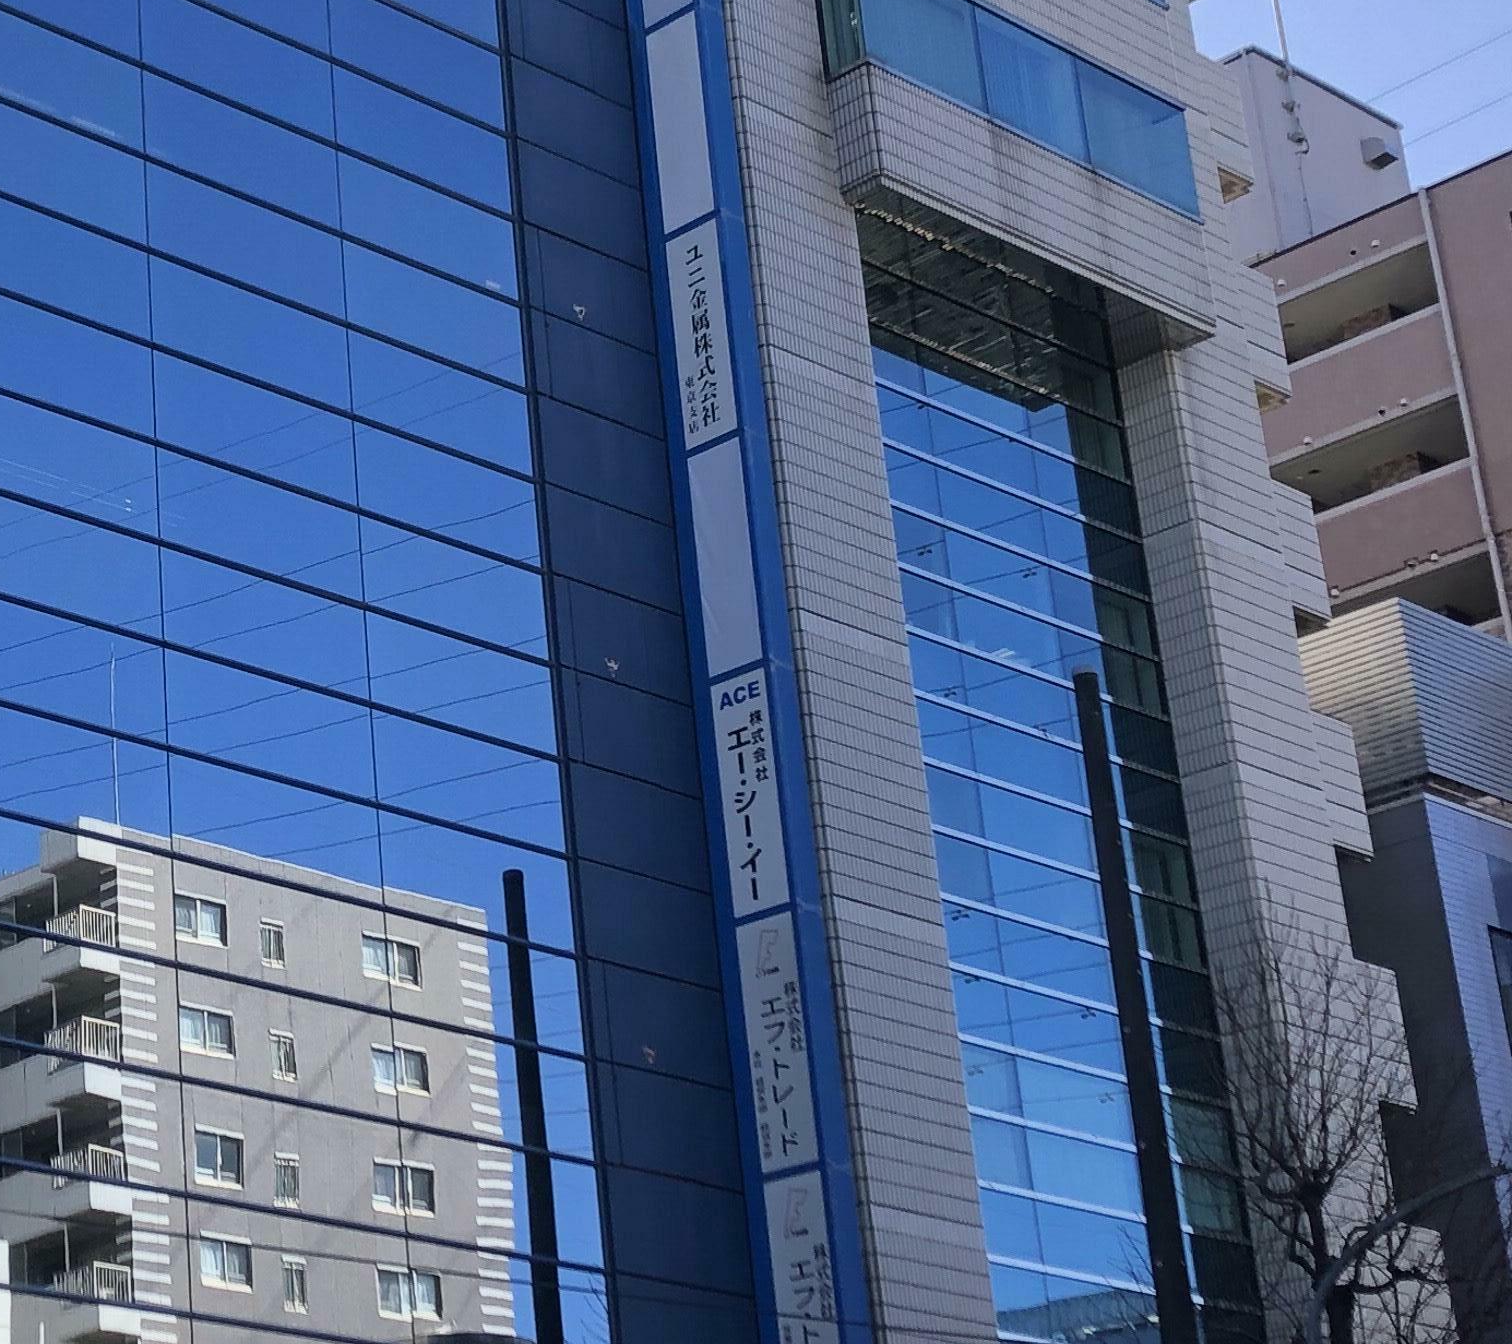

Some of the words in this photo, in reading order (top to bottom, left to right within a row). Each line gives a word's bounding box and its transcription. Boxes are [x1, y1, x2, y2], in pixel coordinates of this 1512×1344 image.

[685, 244, 721, 428] ユニ金属株式会社
[719, 680, 761, 711] ACE
[749, 709, 769, 783] 株式会社
[727, 726, 763, 901] エー・シー・イー
[760, 996, 799, 1157] エフ・トレード
